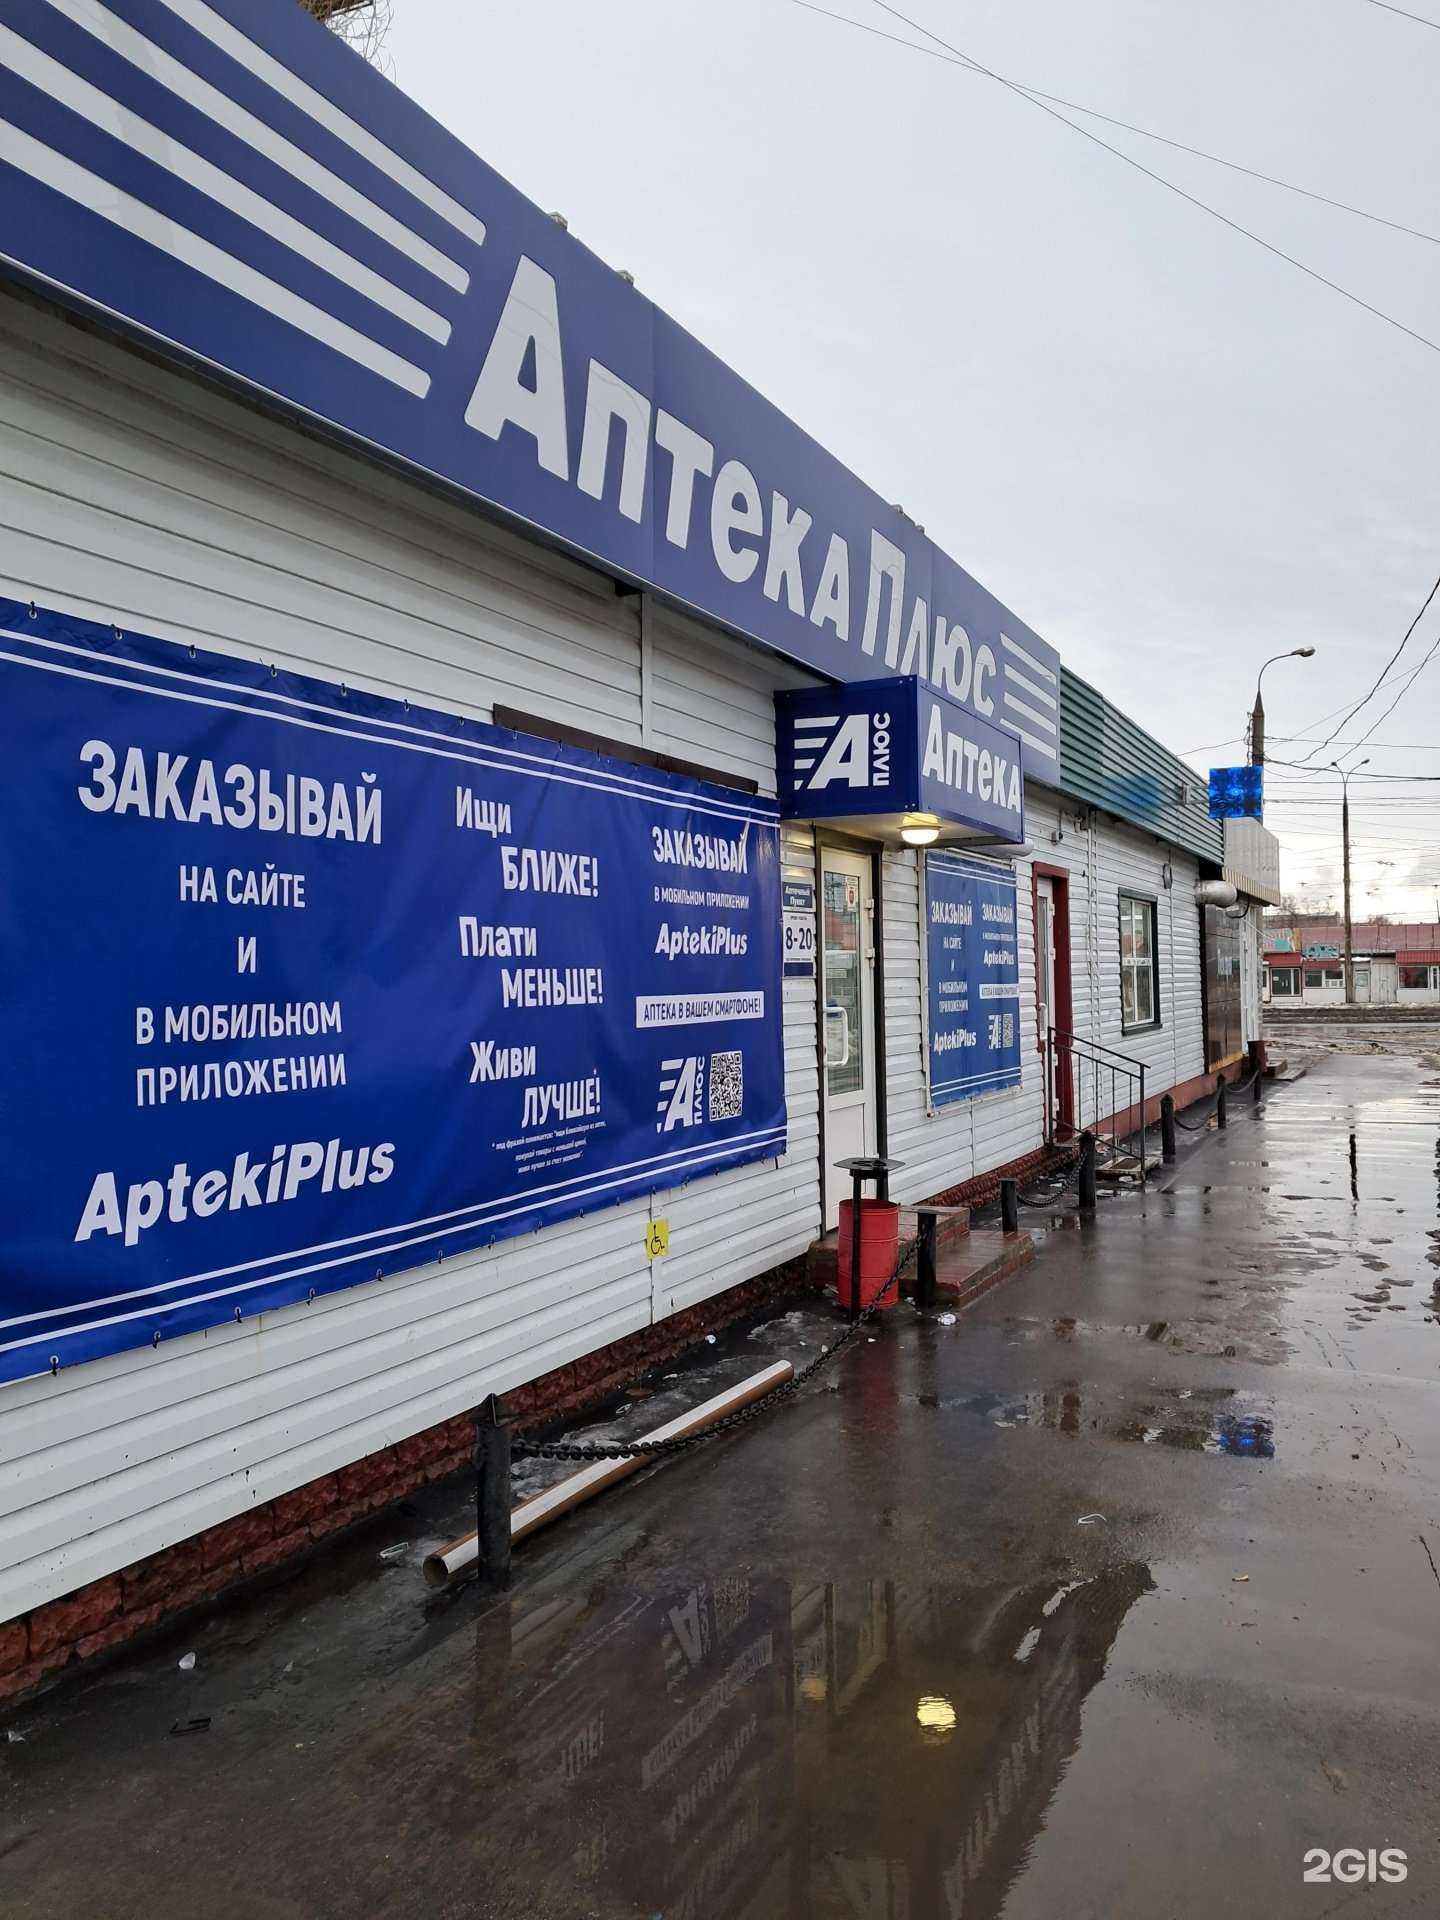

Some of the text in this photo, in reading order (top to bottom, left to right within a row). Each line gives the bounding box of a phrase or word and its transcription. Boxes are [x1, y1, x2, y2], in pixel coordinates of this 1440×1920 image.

[873, 712, 891, 787] ПЛЮС
[78, 739, 383, 845] ЗАКАЗЫВАЙ
[456, 786, 512, 838] Ищи
[652, 826, 748, 874] ЗАКАЗЫВАЙ
[180, 863, 306, 908] НА САЙТЕ
[501, 846, 599, 898] БЛИЖЕ!
[654, 886, 661, 902] В
[662, 887, 705, 906] МОБИЛЬНОМ
[931, 900, 973, 926] ЗАКАЗЫВАЙ
[238, 936, 257, 974] И
[459, 916, 537, 957] Плати
[655, 923, 748, 961] AptekiPlus
[785, 926, 813, 950] 8-20
[501, 968, 603, 1008] МЕНЬШЕ!
[644, 997, 761, 1022] АПТЕКА В ВАШЕМ СМАРТФОНЕ!
[136, 1001, 342, 1045] В МОБИЛЬНОМ
[933, 1028, 977, 1056] AptekiPlus
[136, 1053, 347, 1107] ПРИЛОЖЕНИИ
[469, 1040, 536, 1083] Живи
[74, 1138, 396, 1247] AptekiPlus
